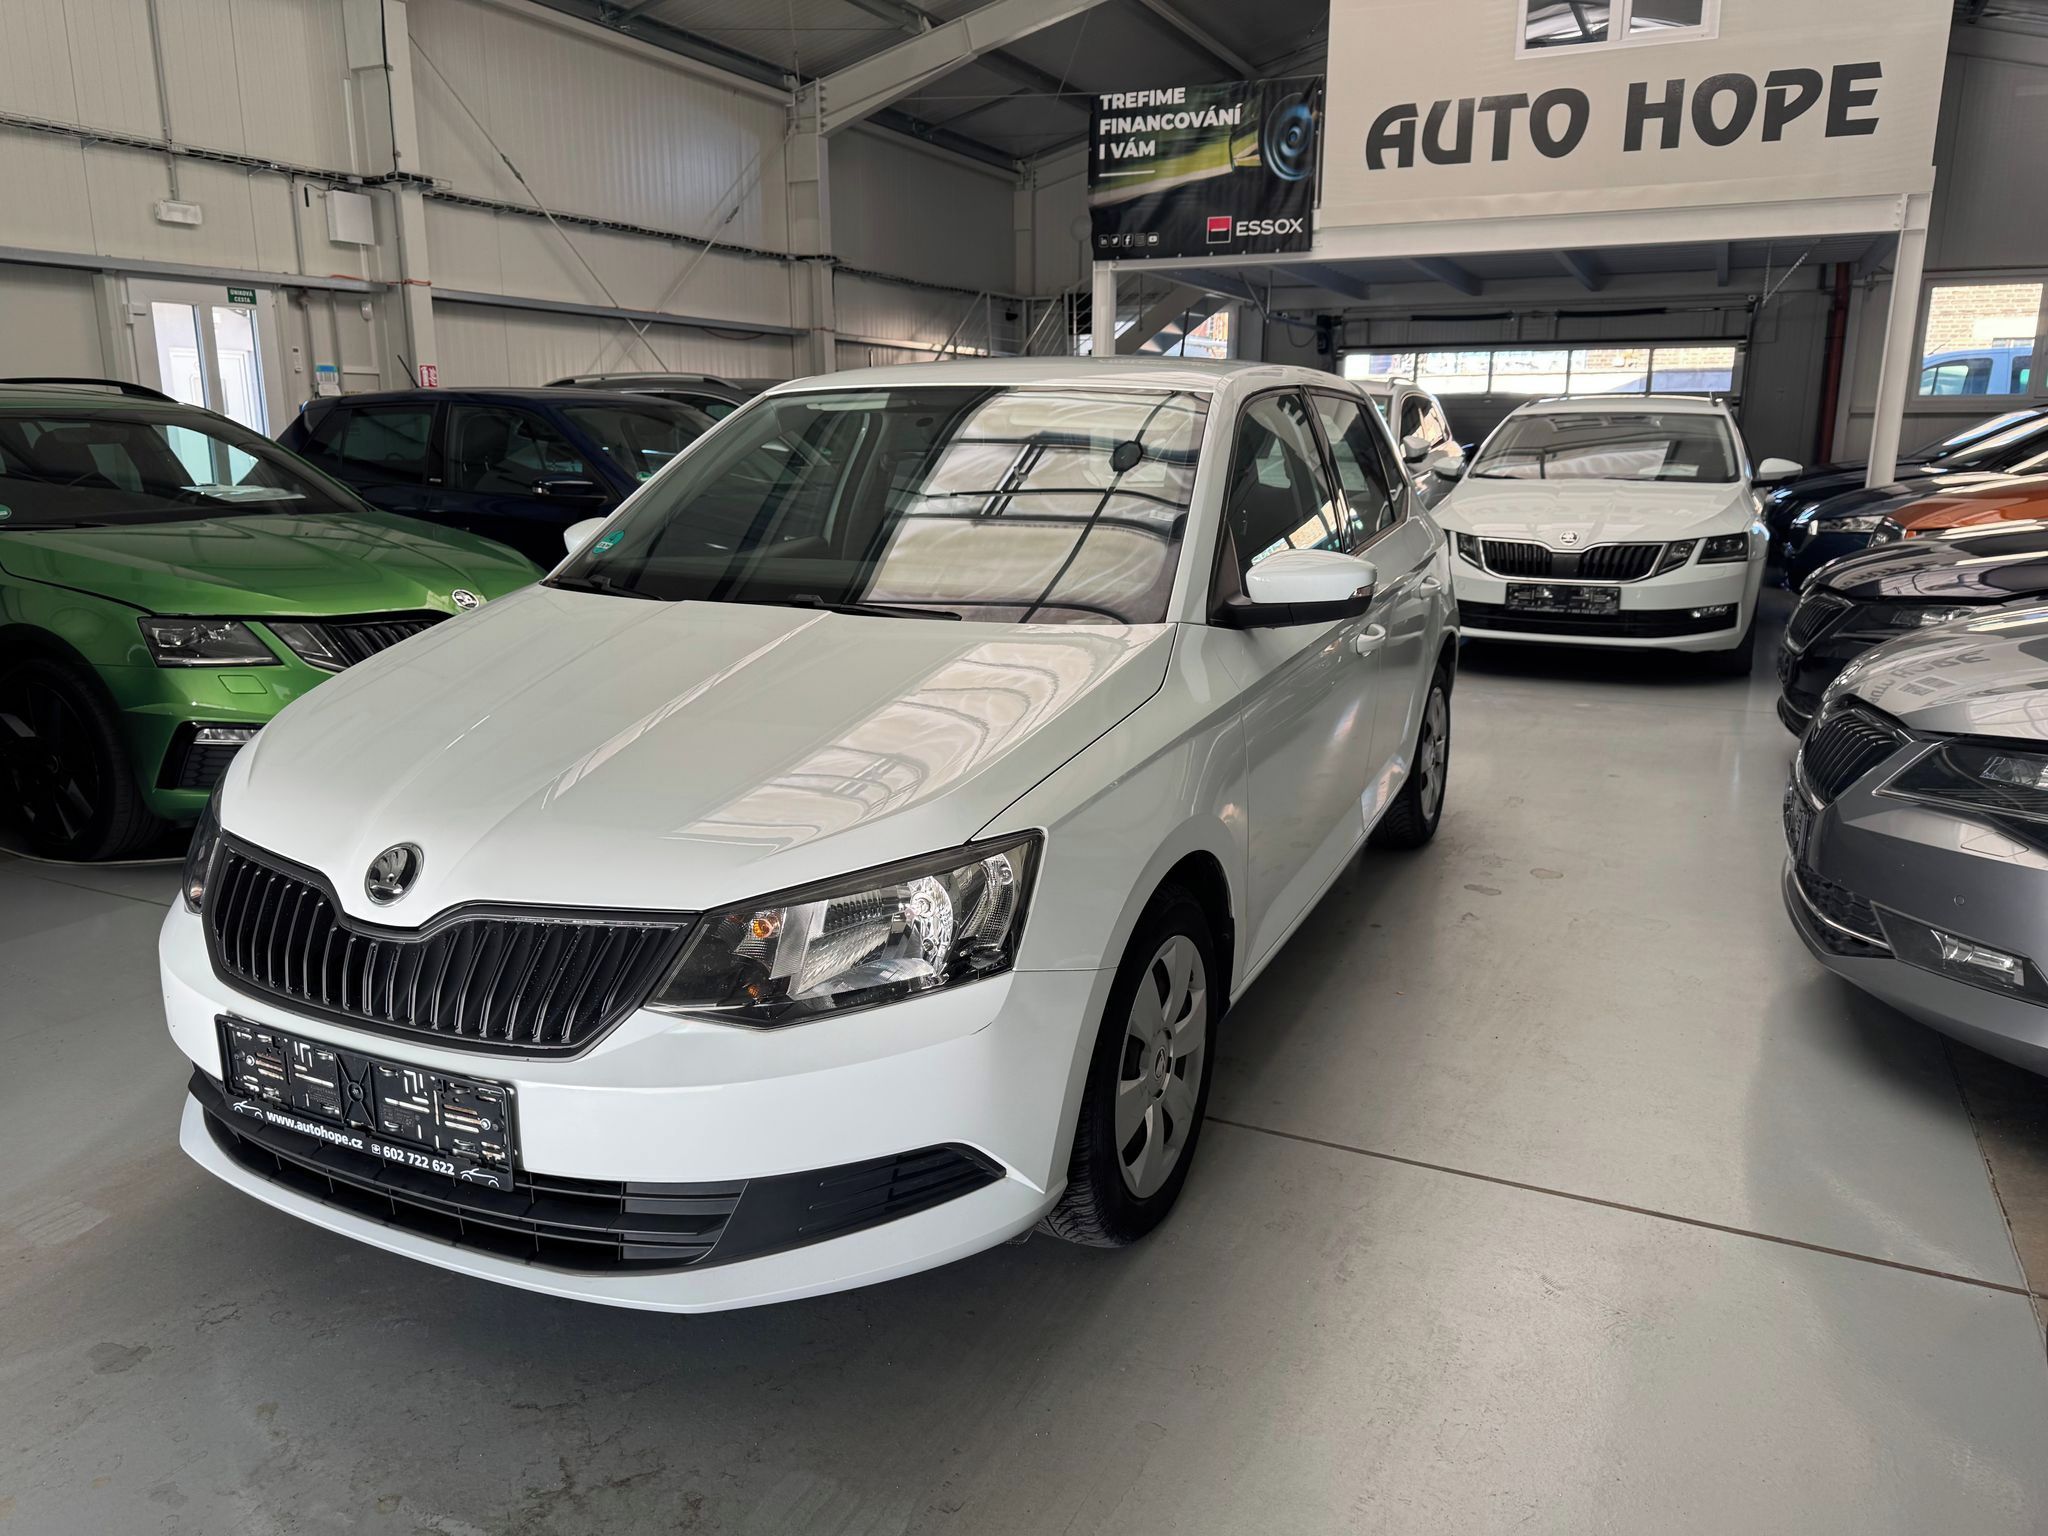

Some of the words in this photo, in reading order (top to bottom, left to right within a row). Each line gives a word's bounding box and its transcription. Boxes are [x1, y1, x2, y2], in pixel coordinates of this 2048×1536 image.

[1100, 87, 1186, 110] TREFIME
[1099, 103, 1242, 135] FINANCOVÁNÍ
[1365, 88, 1590, 170] AUTO
[1623, 61, 1882, 153] HOPE
[1099, 143, 1105, 160] I
[1110, 139, 1155, 160] VÁM
[1236, 216, 1303, 237] ESSOX
[266, 1111, 363, 1149] www.autohope.cz
[383, 1146, 405, 1162] 602
[407, 1152, 429, 1169] 722
[432, 1159, 455, 1176] 622
